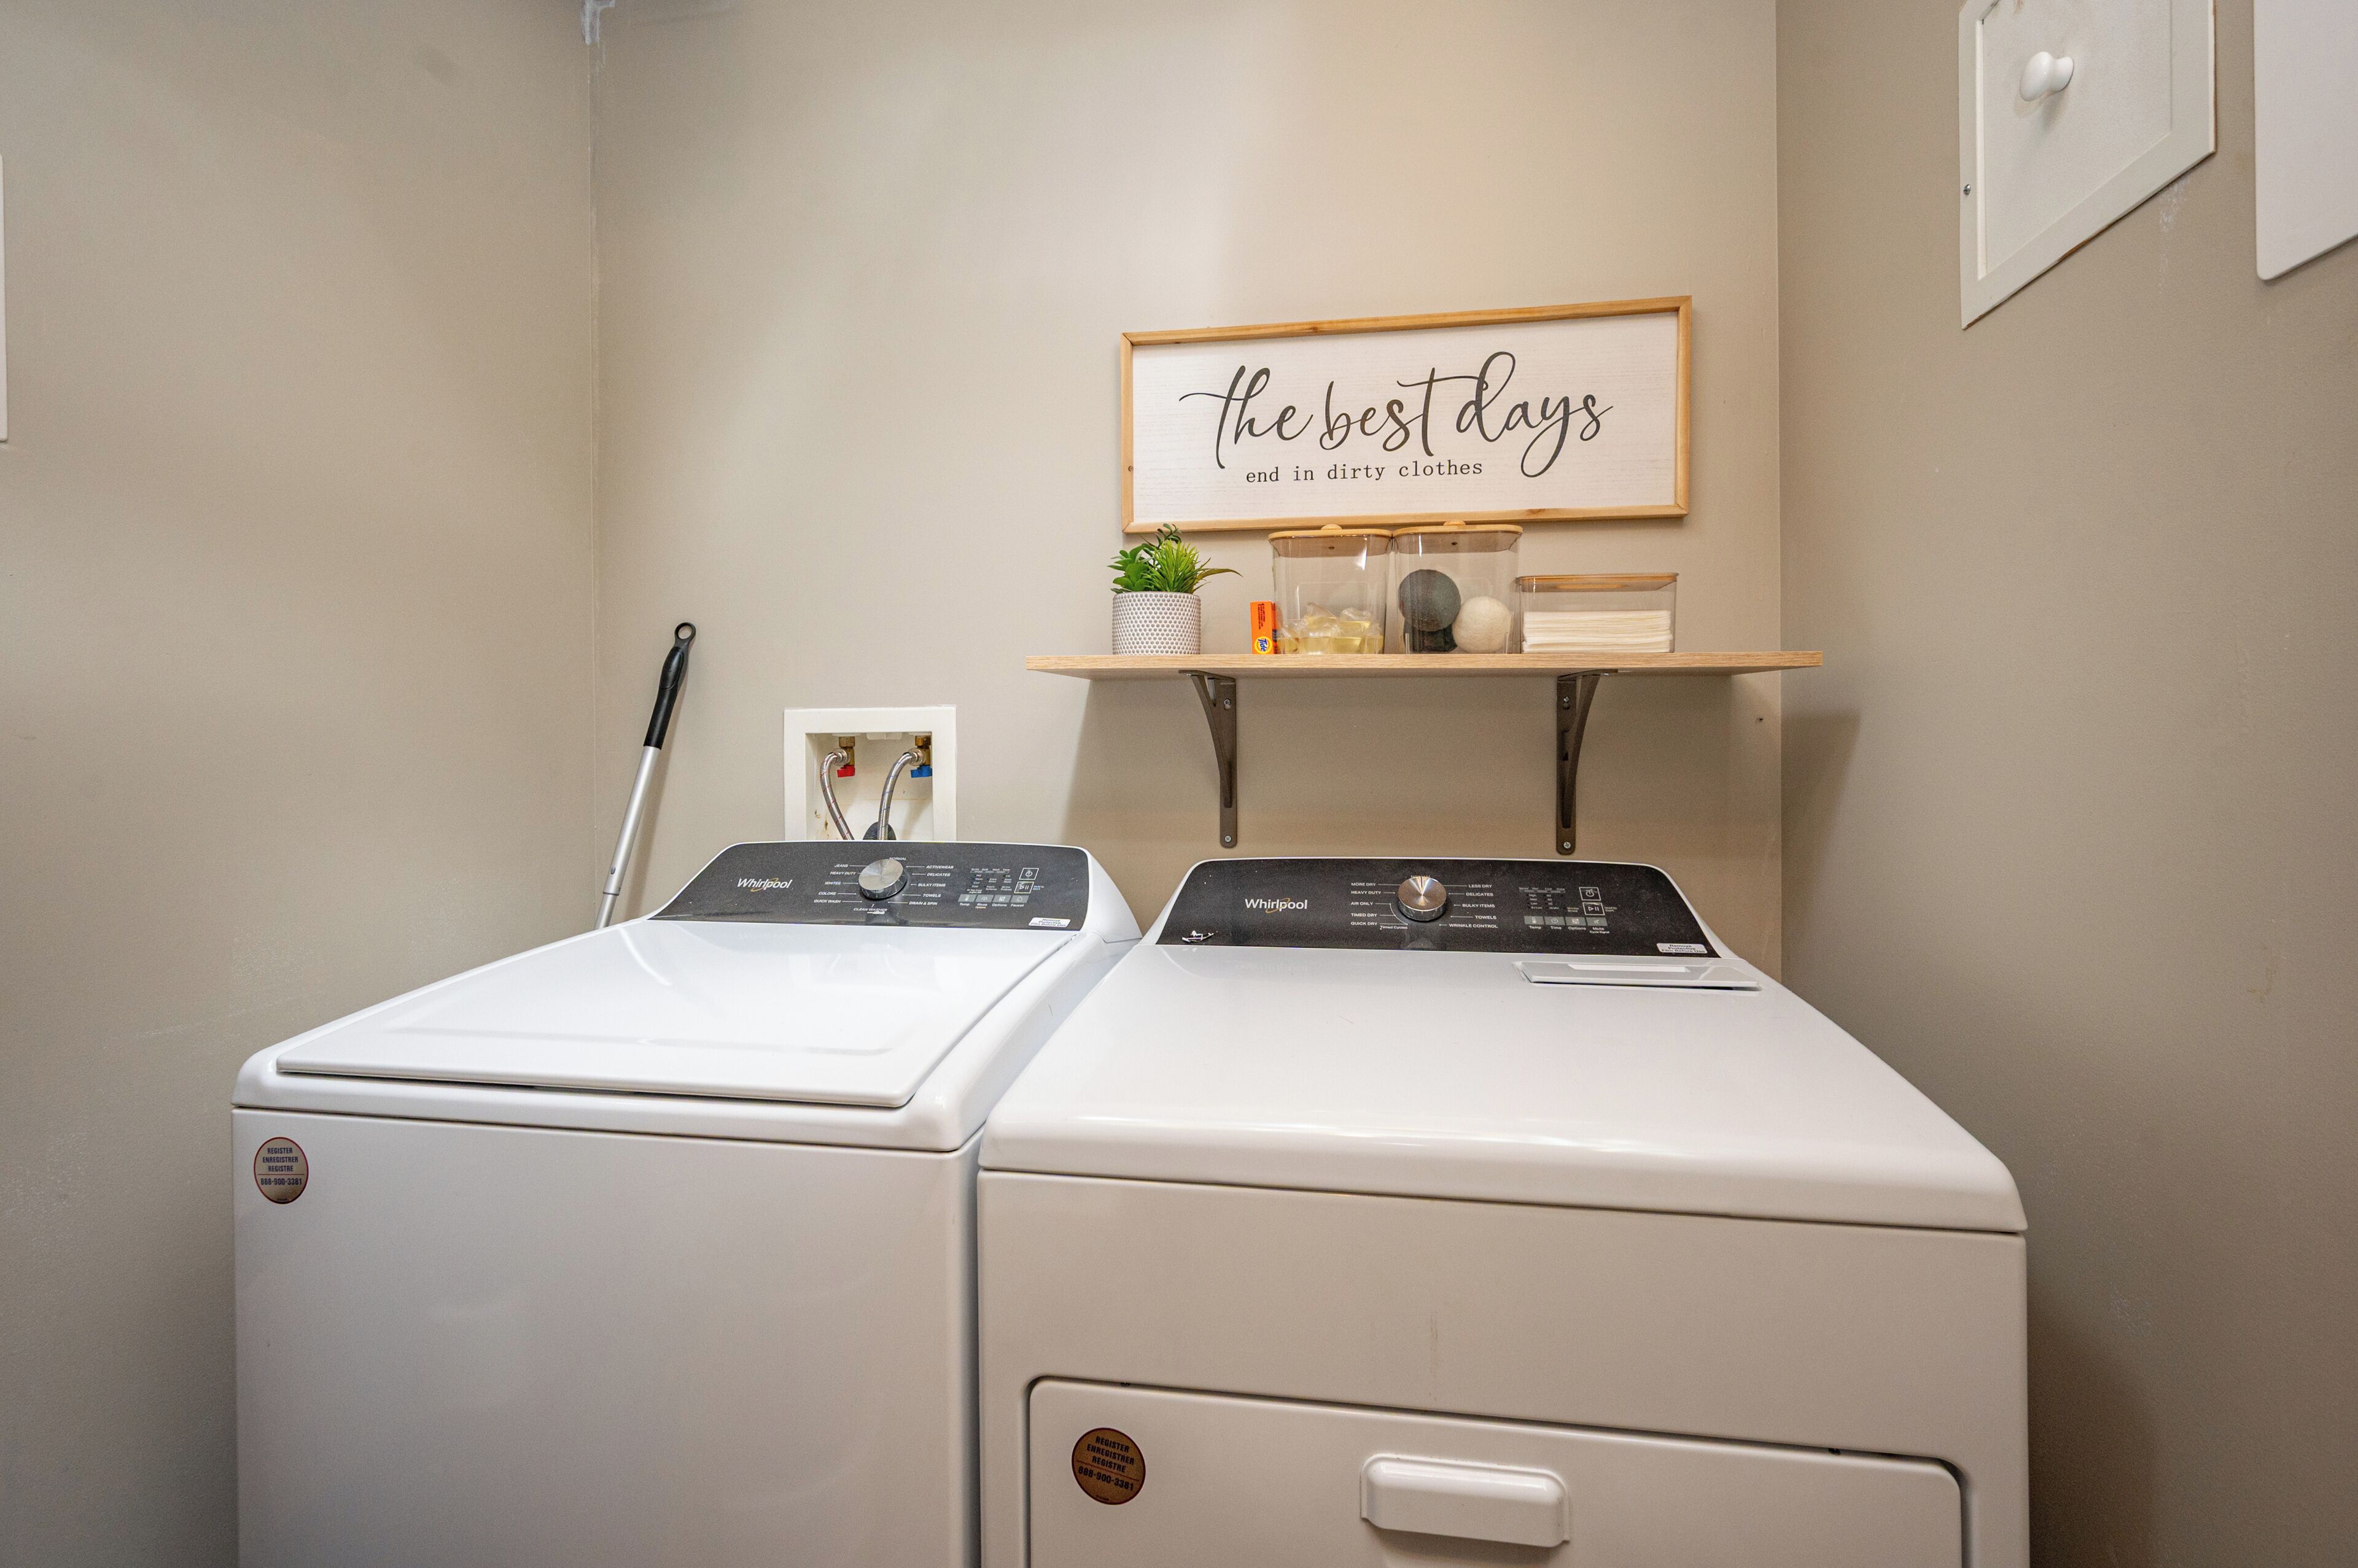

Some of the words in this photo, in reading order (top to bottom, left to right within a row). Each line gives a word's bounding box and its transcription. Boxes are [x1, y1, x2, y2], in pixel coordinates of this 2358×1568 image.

[1179, 365, 1313, 468] the
[1320, 367, 1488, 457] best
[1456, 351, 1614, 478] days
[1246, 467, 1279, 483] end
[1293, 466, 1314, 481] in
[1327, 464, 1386, 481] dirty
[1399, 459, 1483, 477] clothes
[1257, 638, 1268, 652] Tide
[736, 878, 793, 890] Whirlpool
[1245, 899, 1307, 911] Whirlpool
[1095, 1435, 1130, 1453] REGISTER
[1086, 1443, 1135, 1465] ENREGISTRER
[1092, 1455, 1126, 1473] REGISTRE
[1078, 1465, 1134, 1491] 888-900-3381
